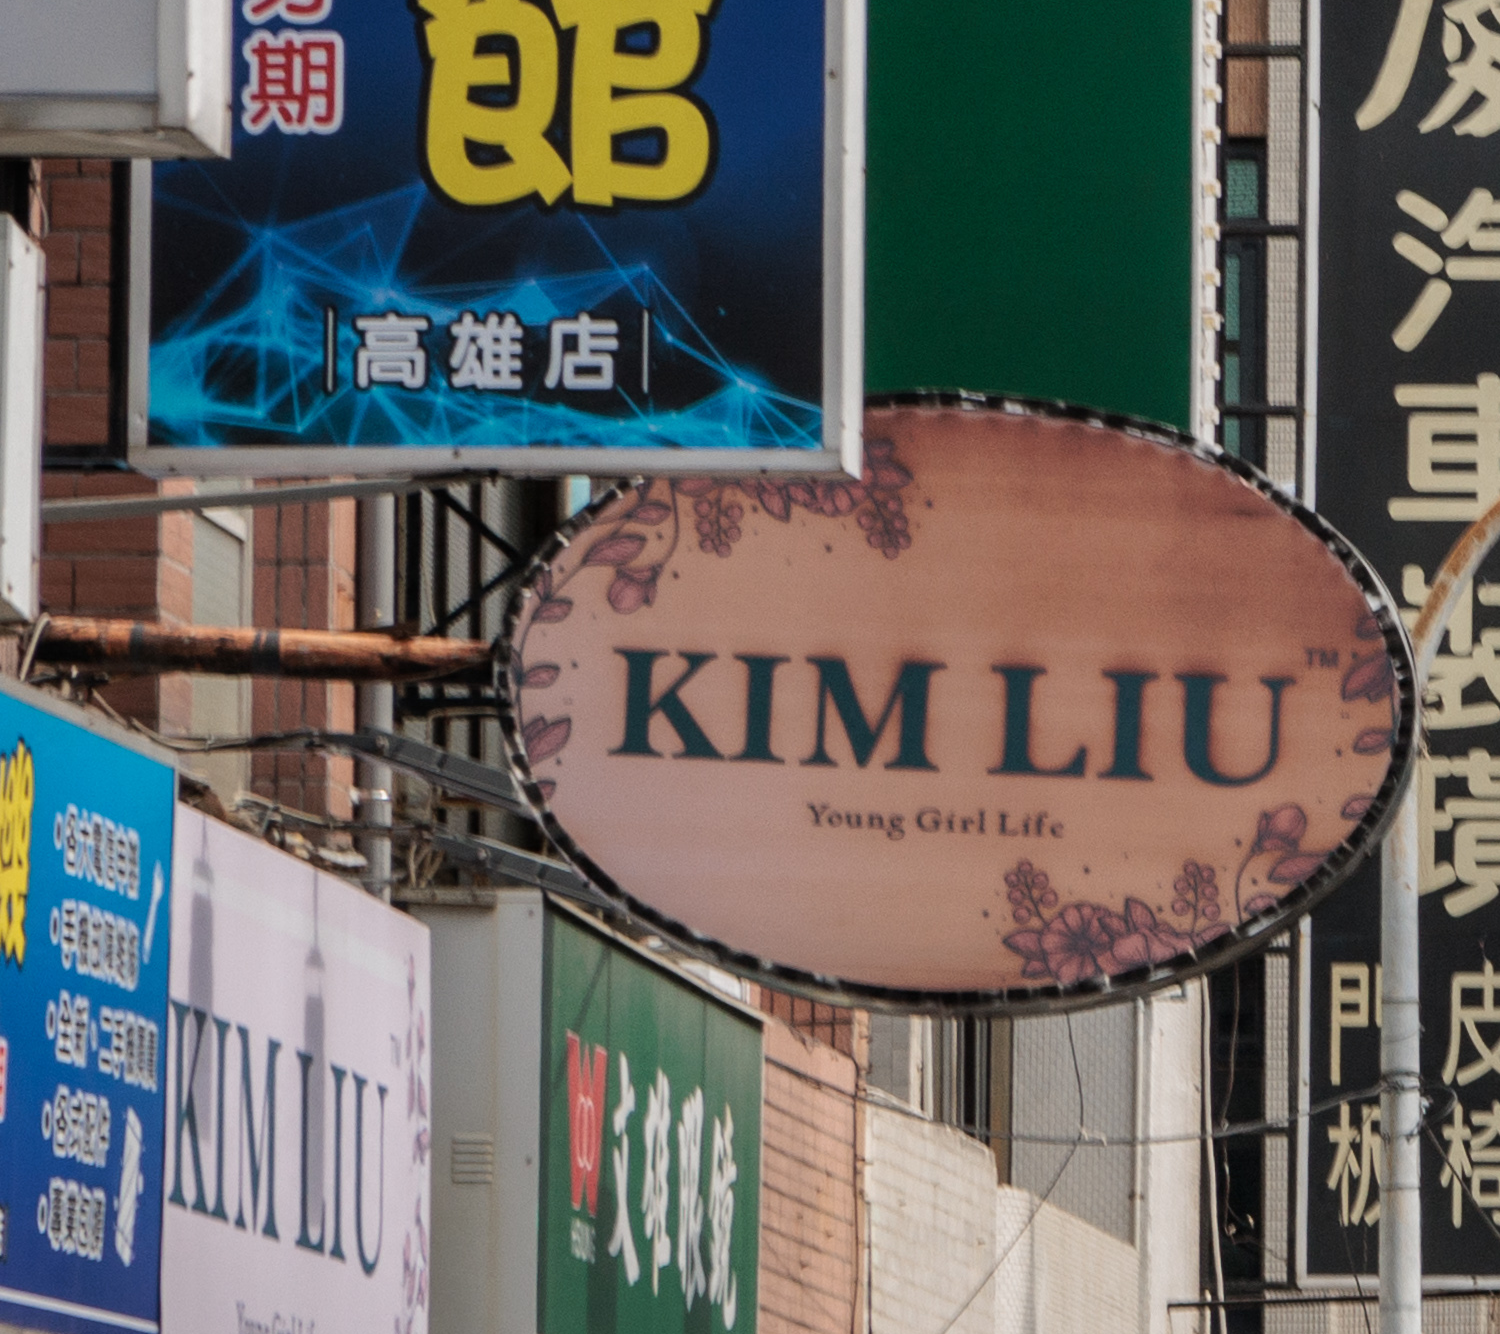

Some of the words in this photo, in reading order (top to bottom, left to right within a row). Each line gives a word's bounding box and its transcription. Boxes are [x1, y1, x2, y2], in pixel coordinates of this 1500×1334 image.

[352, 311, 620, 392] 高雄店
[608, 646, 948, 772] KIM
[986, 663, 1297, 787] LIU
[807, 802, 906, 841] Young
[916, 807, 986, 835] Girl
[997, 811, 1066, 839] Life
[169, 998, 281, 1241] KIM
[296, 1049, 388, 1277] LIU
[608, 1052, 737, 1330] 文雄眼鏡
